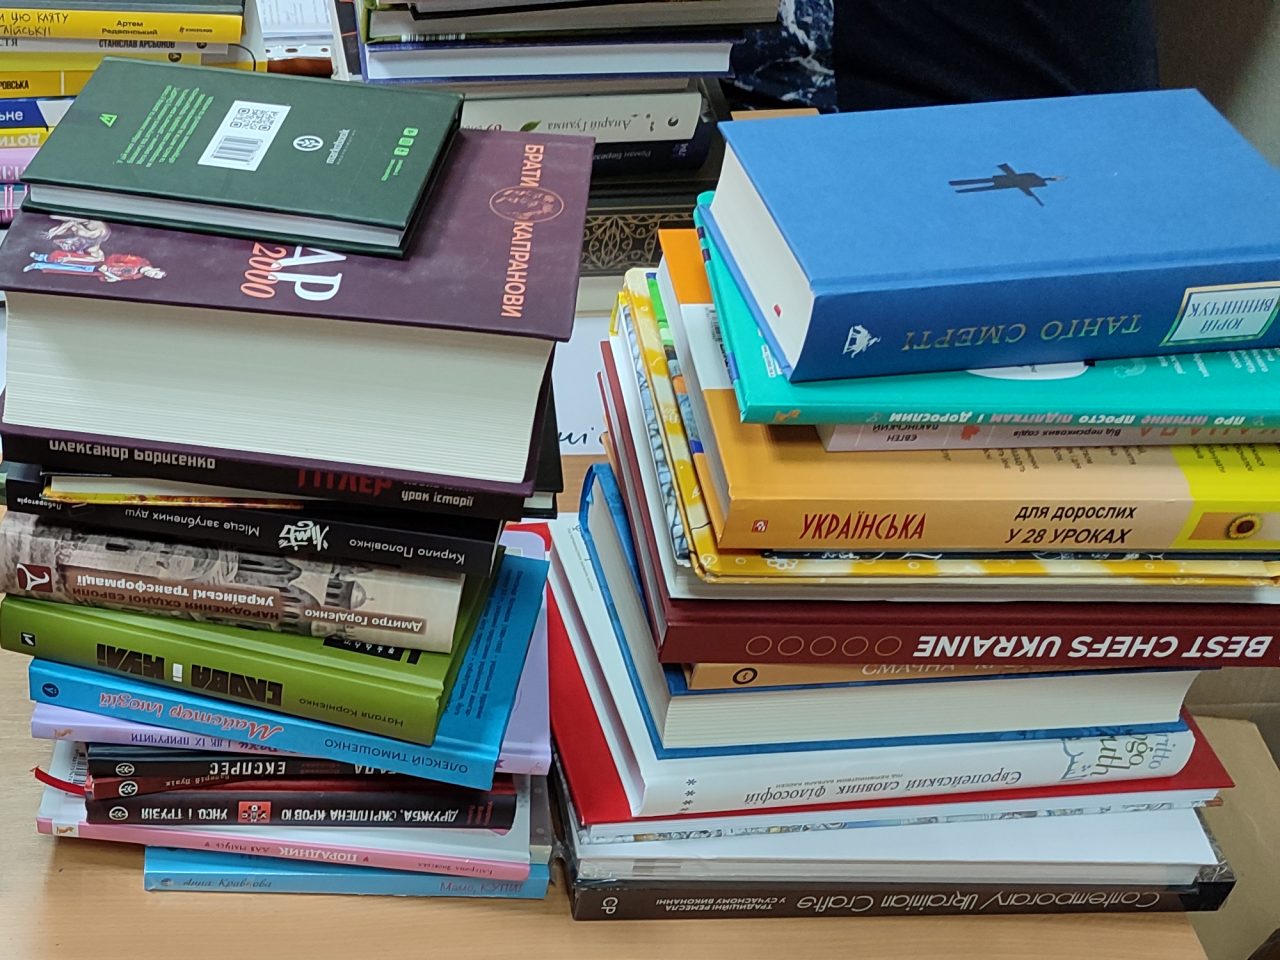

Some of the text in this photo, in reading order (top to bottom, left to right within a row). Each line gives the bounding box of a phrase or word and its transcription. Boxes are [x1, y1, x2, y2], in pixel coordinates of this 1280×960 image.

[10, 13, 32, 25] ЦЮ
[35, 12, 70, 25] КЛЯТУ
[116, 20, 144, 29] Артем
[499, 143, 545, 318] БРАТИ КАПРАНОВИ
[1186, 295, 1277, 320] ВИННИЧУК
[1198, 314, 1245, 335] ЮРІЙ
[900, 318, 1028, 353] СМЕРТІ
[888, 409, 974, 425] ДОРОСЛИМ
[1076, 412, 1137, 427] ПРОСТО
[1213, 413, 1248, 427] ПРО
[885, 432, 918, 443] ЄВГЕН
[1012, 429, 1038, 439] садів
[1100, 427, 1122, 438] Від
[400, 490, 474, 508] урок історії
[1014, 504, 1138, 522] для дорослих
[799, 510, 928, 543] УКРАЇНСЬКА
[124, 507, 466, 566] Кирило Половінко Місце загублених душ
[1005, 529, 1133, 545] У 28 УРОКАХ
[75, 573, 275, 609] українські трансформації
[71, 587, 424, 633] Дмитро Гордієнко НАРОДЖЕННЯ СХІДНОЇ ЄВРОПИ
[913, 634, 1274, 660] BEST CHEFS UKRAINE
[98, 691, 165, 719] ілюзій
[298, 696, 404, 728] Наталя Корнієнко
[169, 700, 286, 742] Майстер
[130, 731, 192, 748] ПРИРУЧИТИ
[324, 737, 417, 766] ТИМОШЕНКО
[209, 760, 287, 778] ЕКСПРЕС
[418, 756, 469, 776] ОЛЕКСІЙ
[744, 769, 1024, 806] Європейський словник філософій
[140, 806, 184, 821] ГРУЗІЯ
[327, 808, 401, 823] СКРІПЛЕНА
[278, 845, 358, 864] ПОРАДНИК
[795, 889, 1161, 912] Contemporary Ukrainian Crafts
